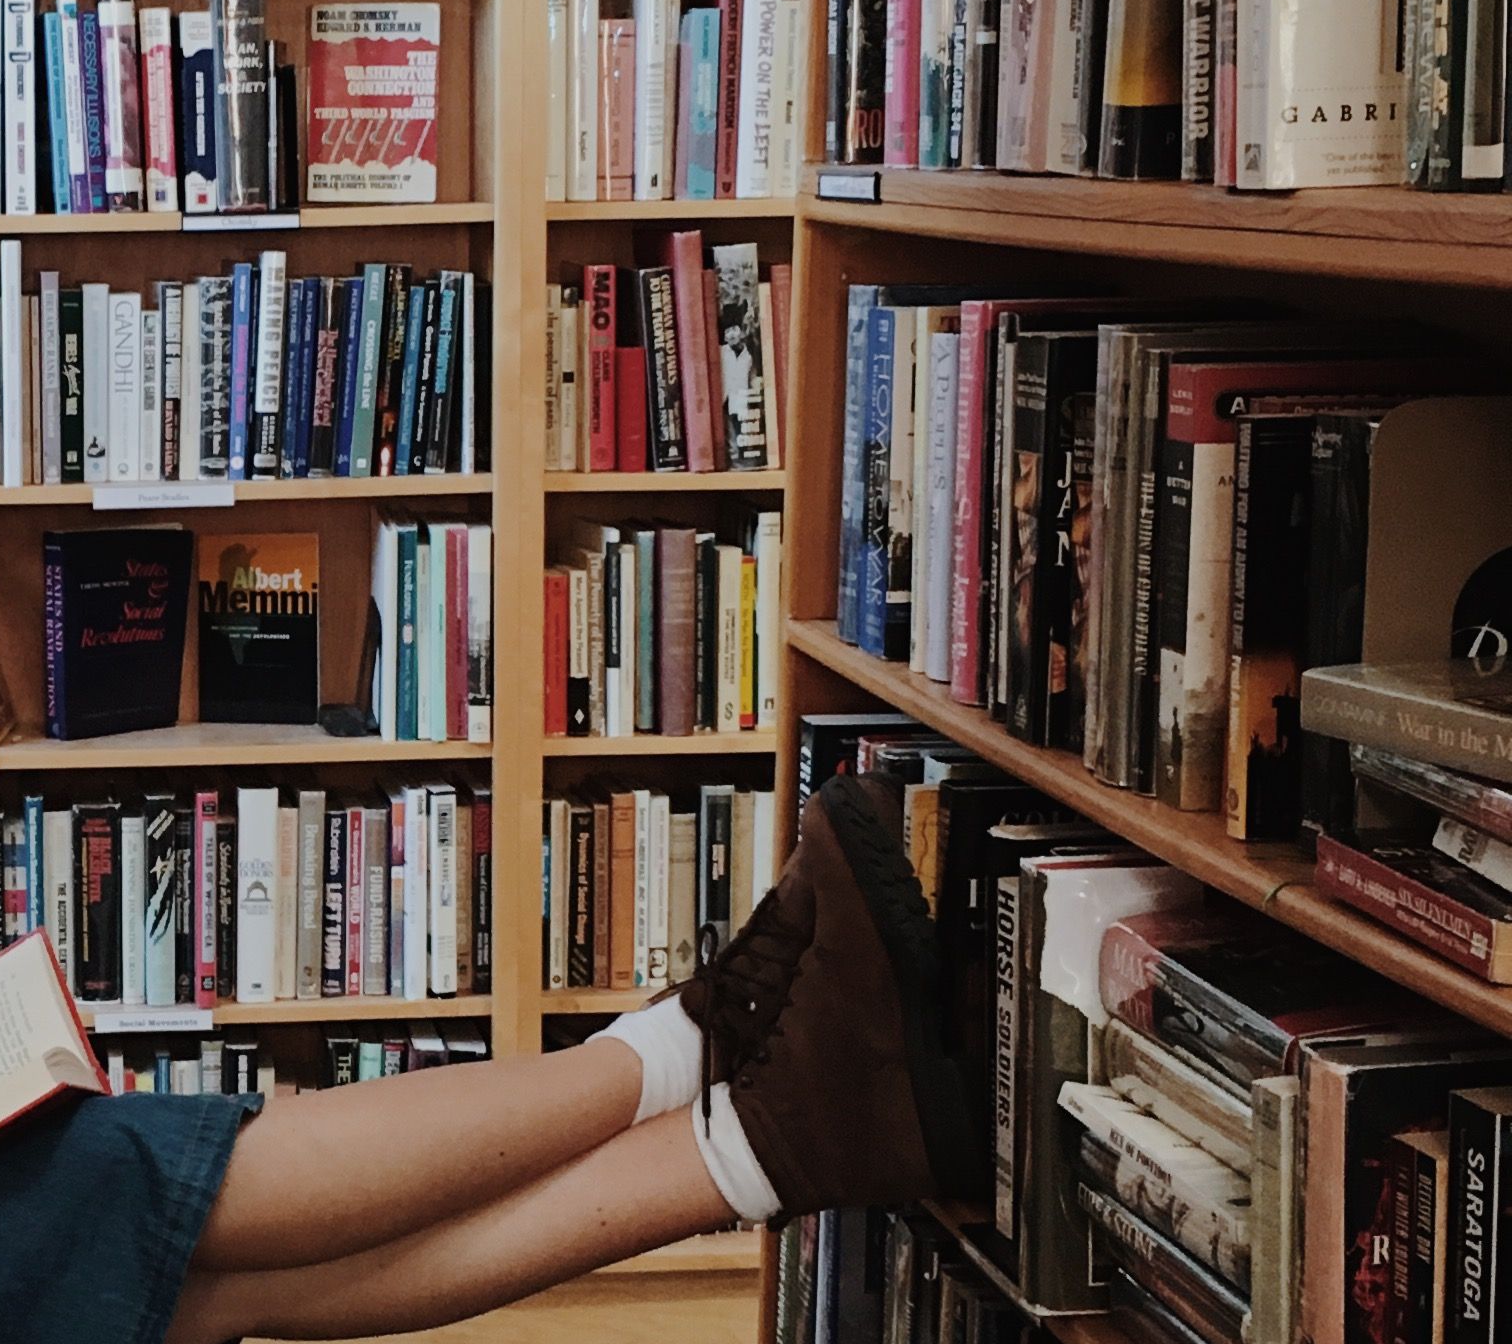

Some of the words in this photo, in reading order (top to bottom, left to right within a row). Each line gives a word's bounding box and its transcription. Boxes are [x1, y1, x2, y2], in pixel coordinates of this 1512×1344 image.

[316, 10, 347, 21] NOAM
[350, 10, 399, 21] CHOMSKY
[756, 0, 777, 57] POWER
[83, 13, 99, 91] NECESSARY
[407, 50, 438, 66] THE
[727, 33, 738, 76] FRENCH
[756, 60, 773, 84] ON
[344, 65, 437, 81] WASHINGTON
[348, 80, 436, 96] CONNECTION
[1188, 14, 1213, 141] WARRIOR
[314, 107, 349, 120] THIRD
[351, 107, 388, 120] WORLD
[411, 95, 436, 109] AND
[724, 77, 736, 129] MARXISM
[754, 87, 771, 119] THE
[86, 94, 102, 158] ILLUSIONS
[753, 122, 769, 169] LEFT
[264, 266, 284, 342] MAKING
[593, 271, 611, 331] MAO
[113, 300, 135, 395] GANDHI
[363, 319, 377, 371] CROSSING
[262, 349, 280, 407] PEACE
[362, 372, 374, 388] the
[360, 389, 372, 409] LINE
[871, 353, 892, 476] HOME
[1236, 422, 1252, 490] WAITING
[873, 484, 888, 519] TO
[1235, 492, 1250, 525] FOR
[1235, 526, 1248, 549] AN
[231, 566, 303, 592] Albert
[866, 517, 885, 607] WAR
[1232, 550, 1248, 599] ARMY
[54, 566, 63, 618] STATES
[124, 600, 169, 620] Social
[198, 580, 318, 615] Memmi
[1232, 601, 1246, 622] TO
[54, 621, 64, 653] AND
[80, 625, 165, 648] Revolutions
[1395, 711, 1431, 743] War
[1437, 719, 1456, 746] in
[1460, 726, 1488, 755] the
[302, 823, 318, 887] Breaking
[576, 832, 590, 874] Dynamics
[57, 882, 68, 898] THE
[577, 874, 590, 885] of
[577, 885, 589, 913] Social
[304, 889, 317, 930] Bread
[326, 882, 343, 921] LEFT
[349, 885, 362, 925] WORLD
[369, 865, 384, 964] FUND-RAISING
[57, 900, 69, 947] ACCIDENTAL
[575, 914, 589, 945] Change
[324, 923, 342, 970] TURN
[996, 889, 1015, 1001] HORSE
[118, 1019, 146, 1028] Social
[148, 1018, 198, 1028] Movements
[996, 1005, 1012, 1130] SOLDIERS
[1414, 1235, 1431, 1264] DAY
[1462, 1147, 1486, 1322] SARATOGA
